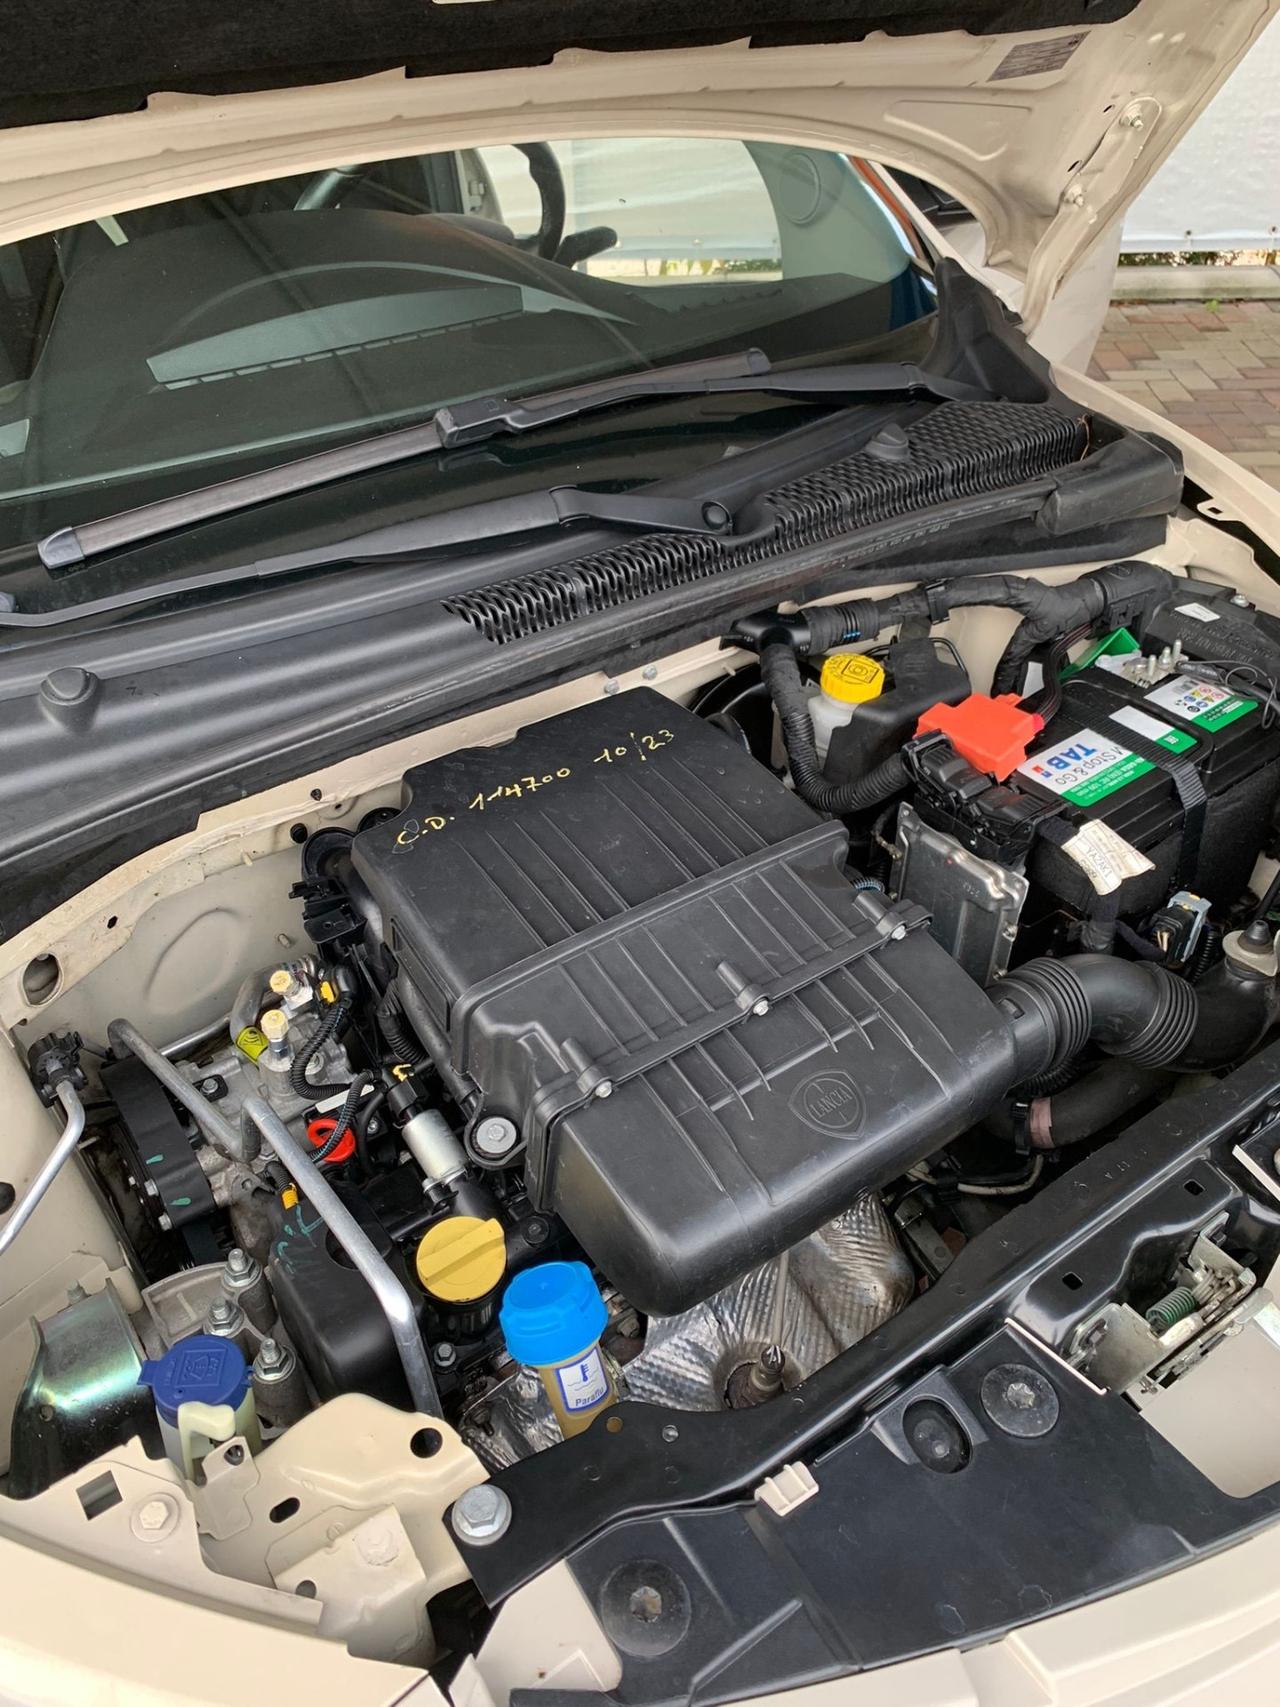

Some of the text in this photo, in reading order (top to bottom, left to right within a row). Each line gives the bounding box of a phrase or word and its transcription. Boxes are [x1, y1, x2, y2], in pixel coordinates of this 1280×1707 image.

[1047, 743, 1097, 770] TAB
[1083, 751, 1117, 770] Stop
[469, 767, 572, 810] 114700
[809, 1088, 853, 1118] LANCIA
